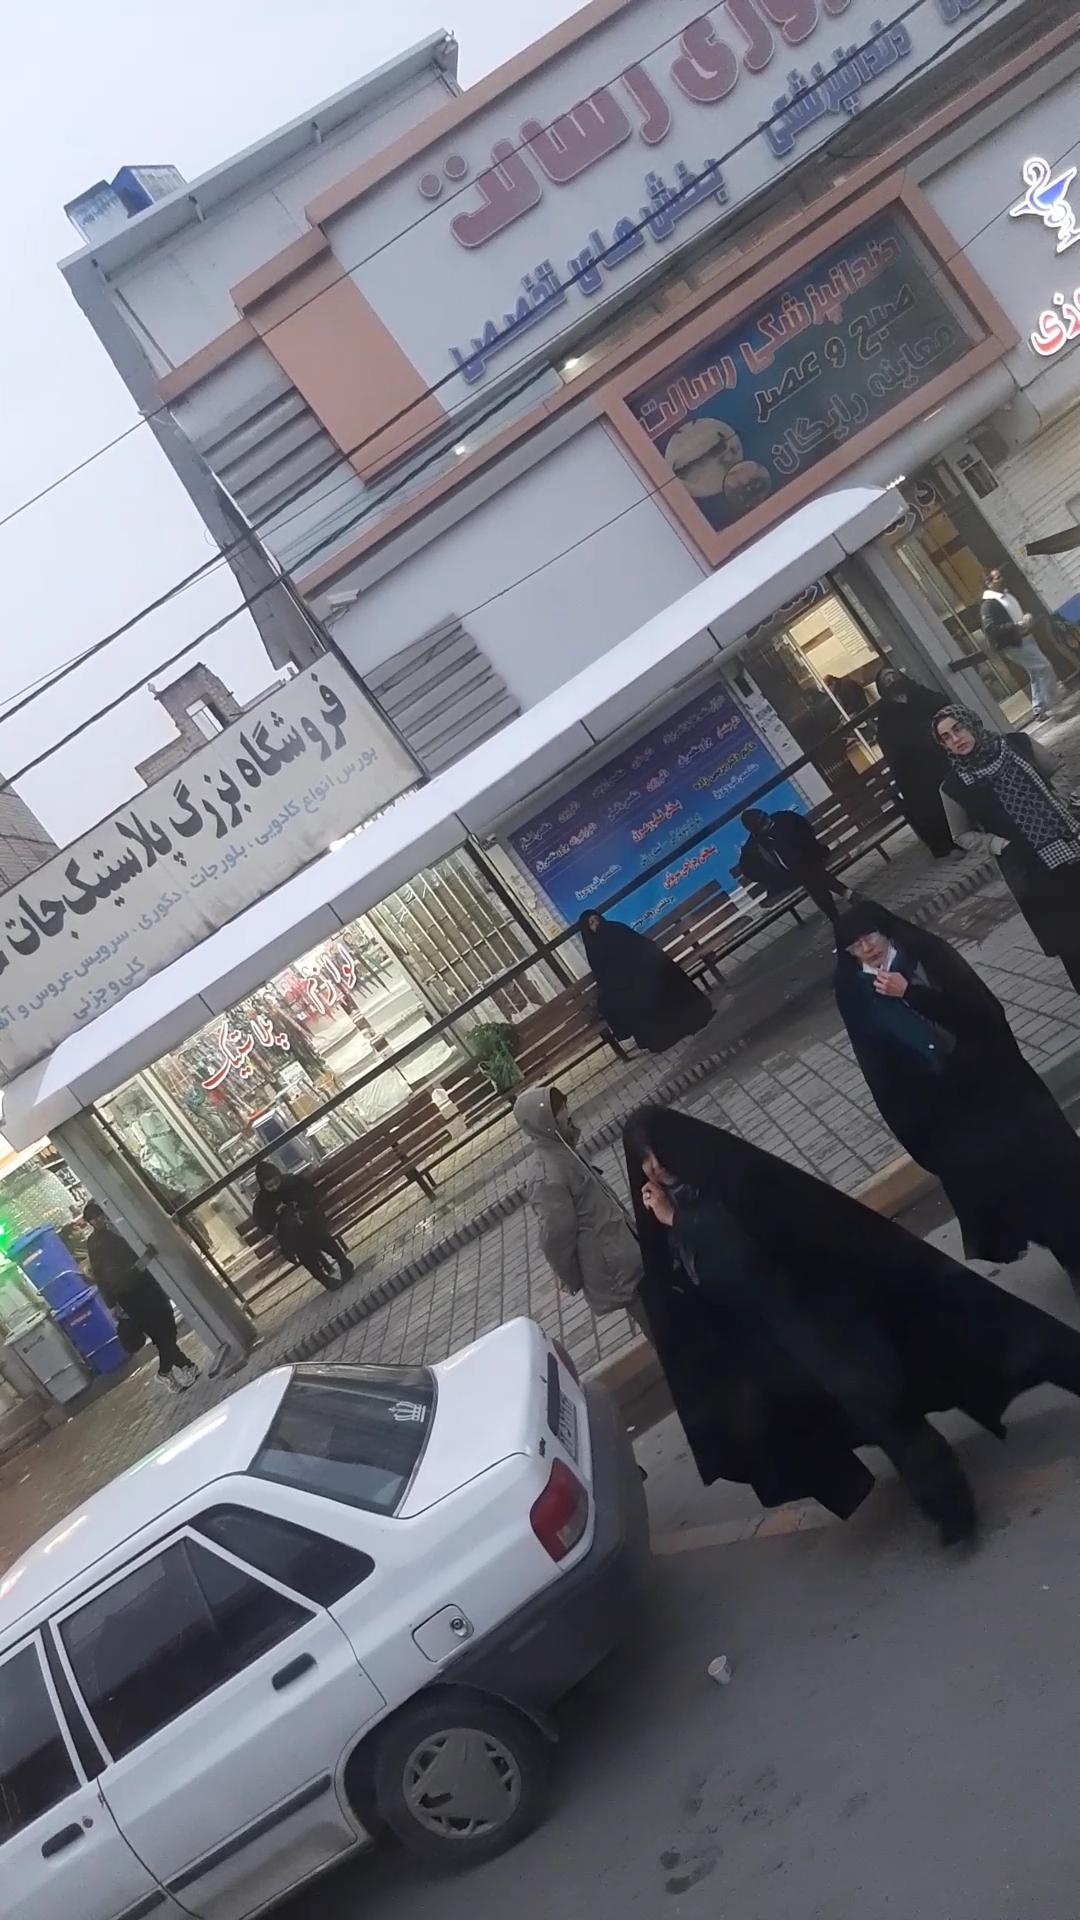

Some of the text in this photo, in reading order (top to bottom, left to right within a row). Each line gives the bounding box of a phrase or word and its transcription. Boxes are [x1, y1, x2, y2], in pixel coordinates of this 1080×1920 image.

[760, 19, 913, 157] دندانپزشکی
[418, 64, 671, 249] رسالت
[640, 156, 730, 240] بخش
[449, 259, 567, 384] تخصصی
[640, 234, 901, 435] دندانپزشکی رسالت
[755, 284, 917, 423] صبح و عصر
[772, 324, 957, 476] معاینه رایگان
[236, 672, 348, 789] فروشگاه
[339, 746, 377, 784] بورس
[171, 774, 251, 841] بزرگ
[300, 776, 335, 814] انواع
[30, 971, 74, 1010] عروس
[75, 930, 129, 977] سرویس
[108, 980, 120, 995] و
[118, 956, 145, 987] کلی
[17, 1005, 30, 1019] و
[202, 942, 357, 1090] لوازم پلاستیک
